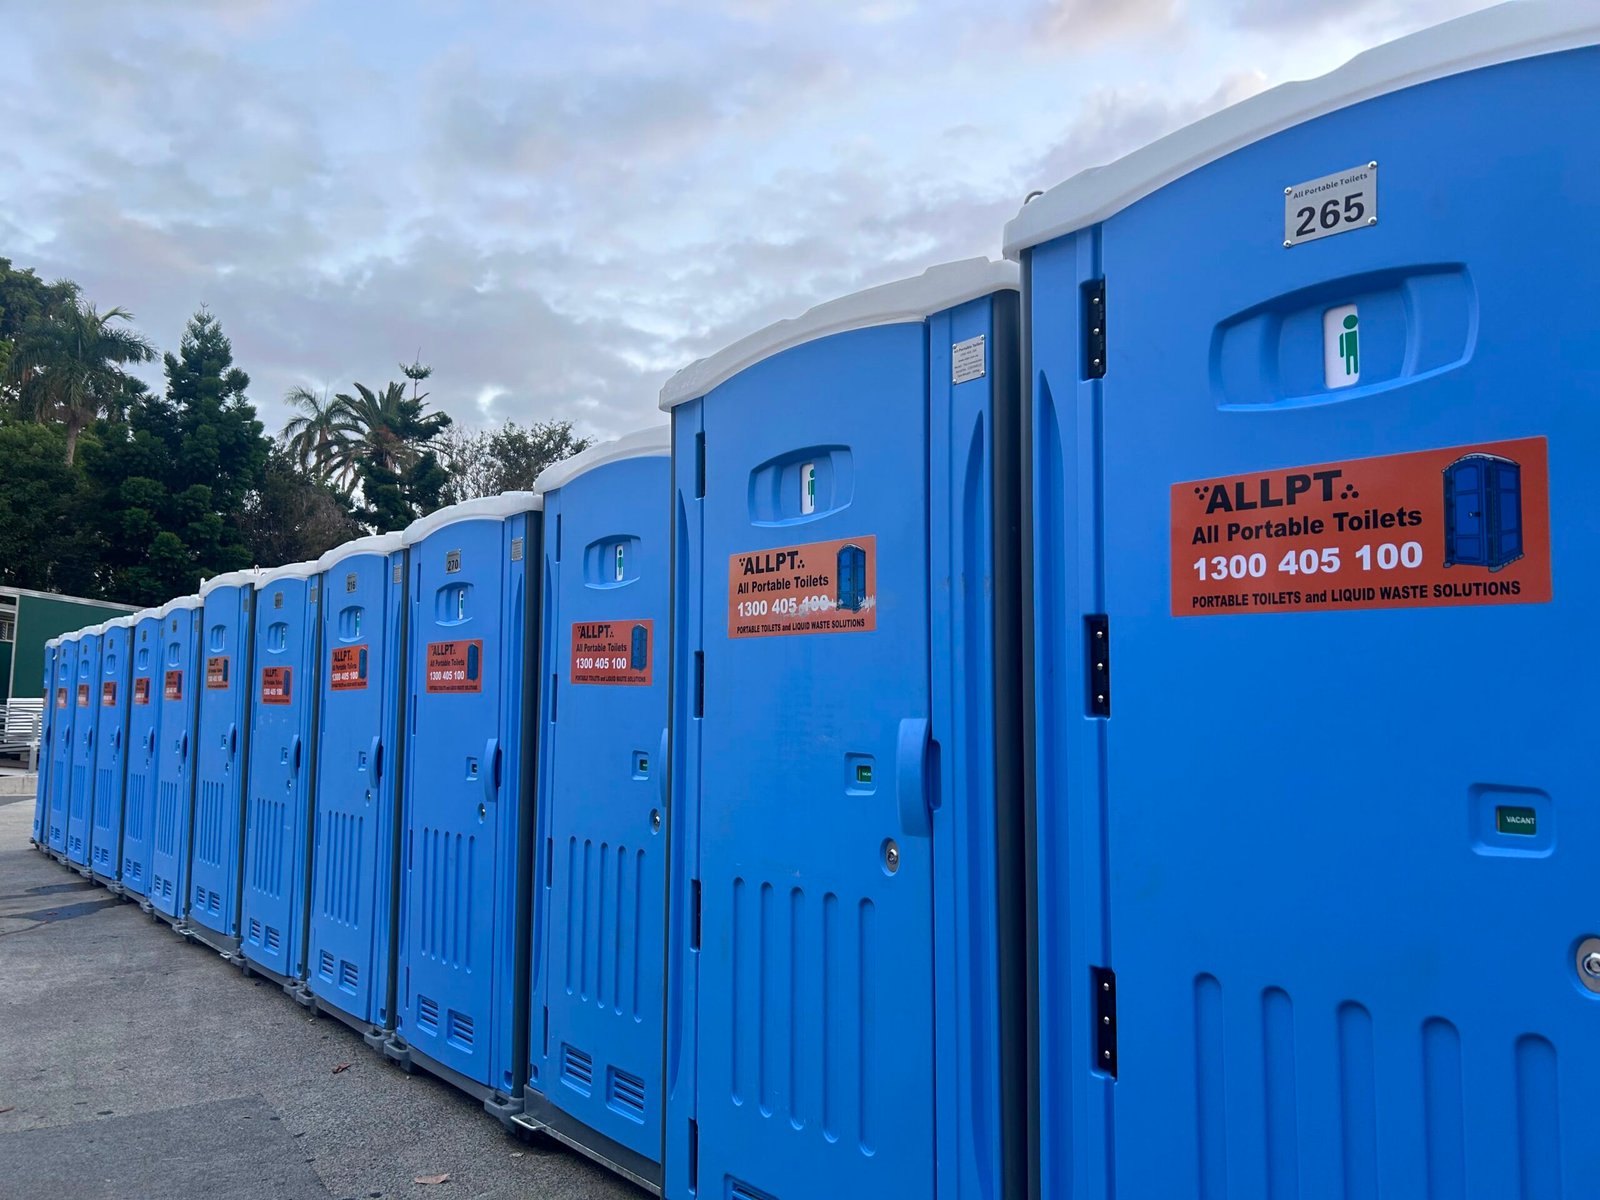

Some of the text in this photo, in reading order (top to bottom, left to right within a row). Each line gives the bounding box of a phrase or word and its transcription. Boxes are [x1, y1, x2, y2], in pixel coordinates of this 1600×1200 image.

[1293, 173, 1368, 199] All Portable Toilets
[1296, 192, 1364, 236] 265
[1192, 506, 1422, 545] All Portable Toilets
[448, 559, 458, 571] 270
[1193, 541, 1423, 581] 1300 405 100
[738, 574, 829, 594] All Portable Toilets
[1192, 580, 1521, 608] PORTABLE TOILETS and LIQUID WASTE SOLUTIONS
[738, 600, 768, 617] 1300
[772, 597, 798, 614] 405
[736, 626, 760, 634] PORTABLE
[761, 624, 780, 632] TOILETS
[792, 622, 810, 631] LIQUID
[811, 621, 830, 630] WASTE
[832, 618, 865, 628] SOLUTIONS
[584, 644, 606, 652] Portable
[608, 643, 627, 652] Toilets
[576, 658, 627, 669] 1300 405 100
[454, 671, 464, 680] 100
[1506, 815, 1535, 825] VACANT
